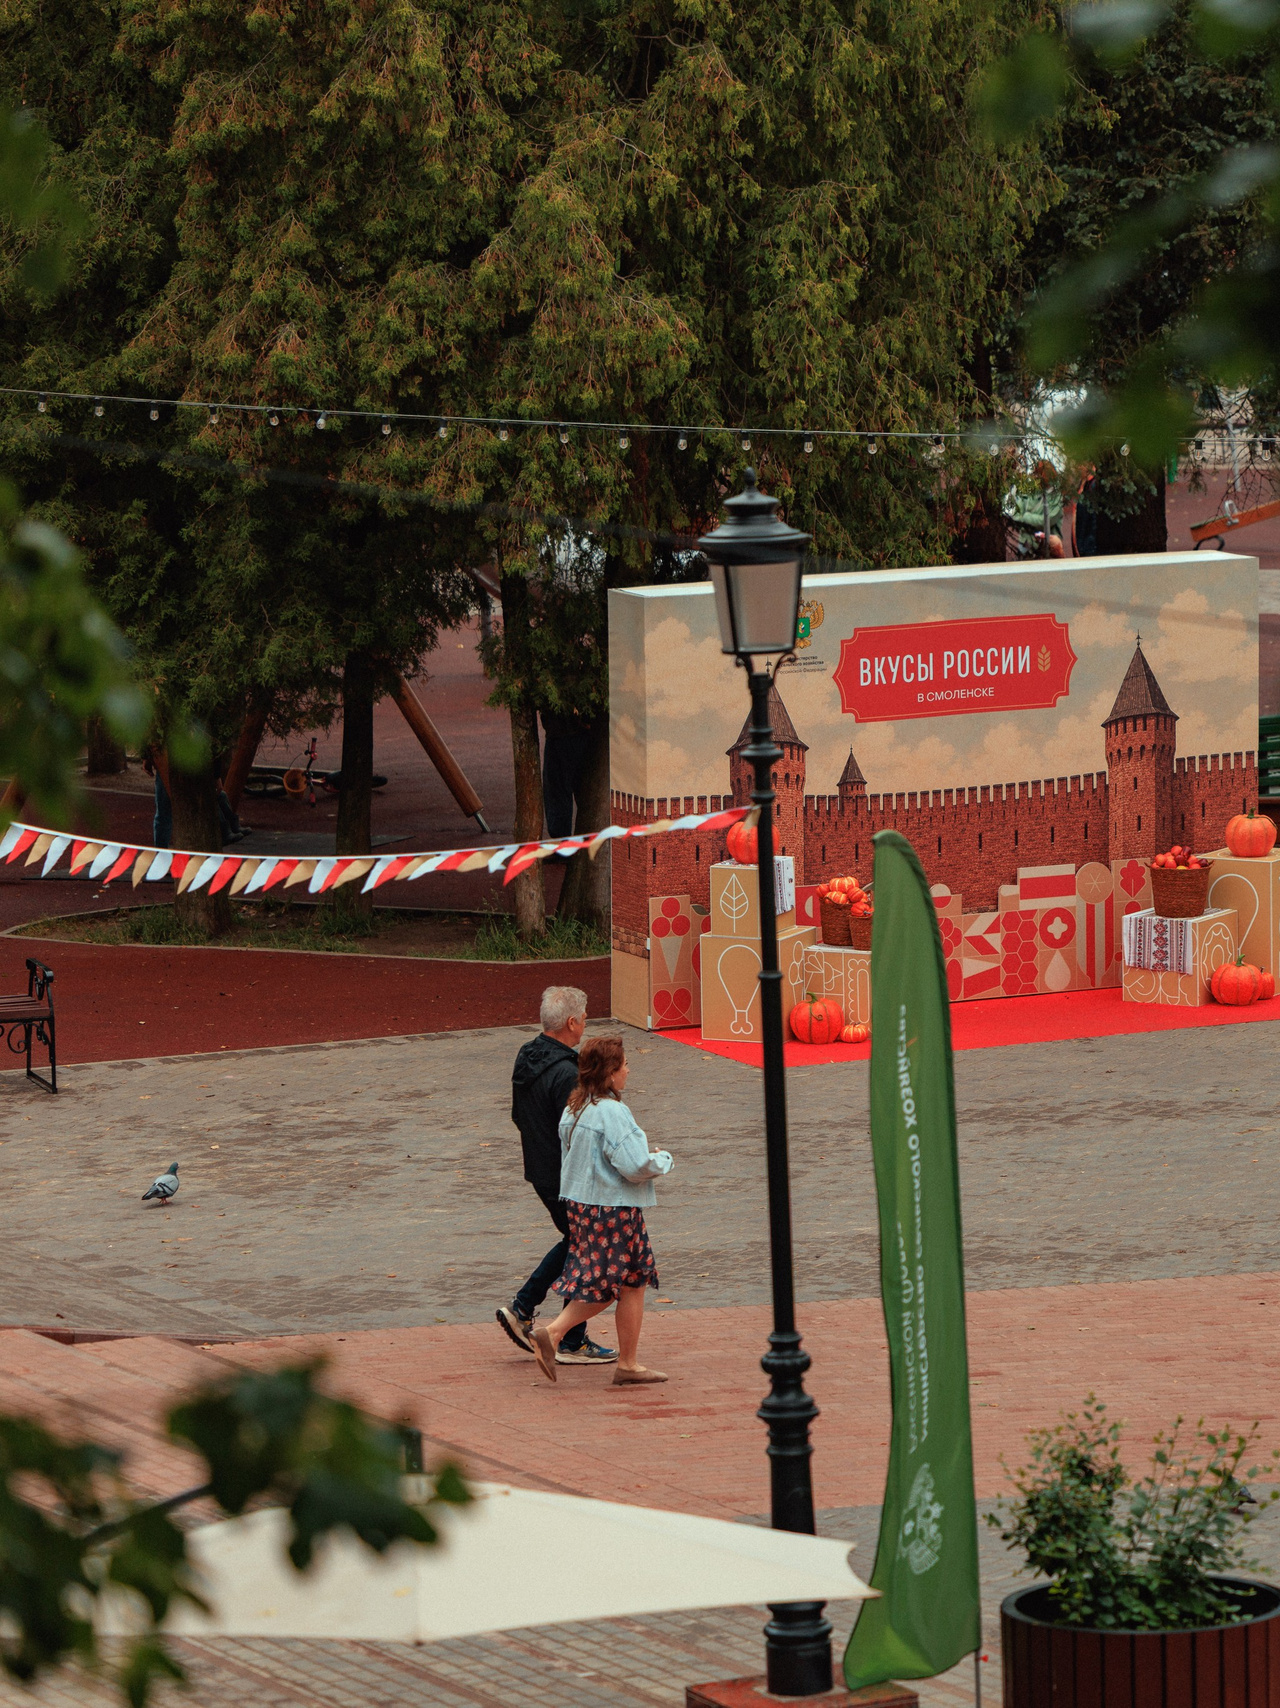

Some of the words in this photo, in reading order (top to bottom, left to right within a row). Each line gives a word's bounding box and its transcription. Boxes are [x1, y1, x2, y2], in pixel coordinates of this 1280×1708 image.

[859, 652, 934, 687] ВКУСЫ
[943, 645, 1031, 680] РОССИИ
[917, 692, 924, 703] В
[926, 686, 995, 702] СМОЛЕНСКЕ
